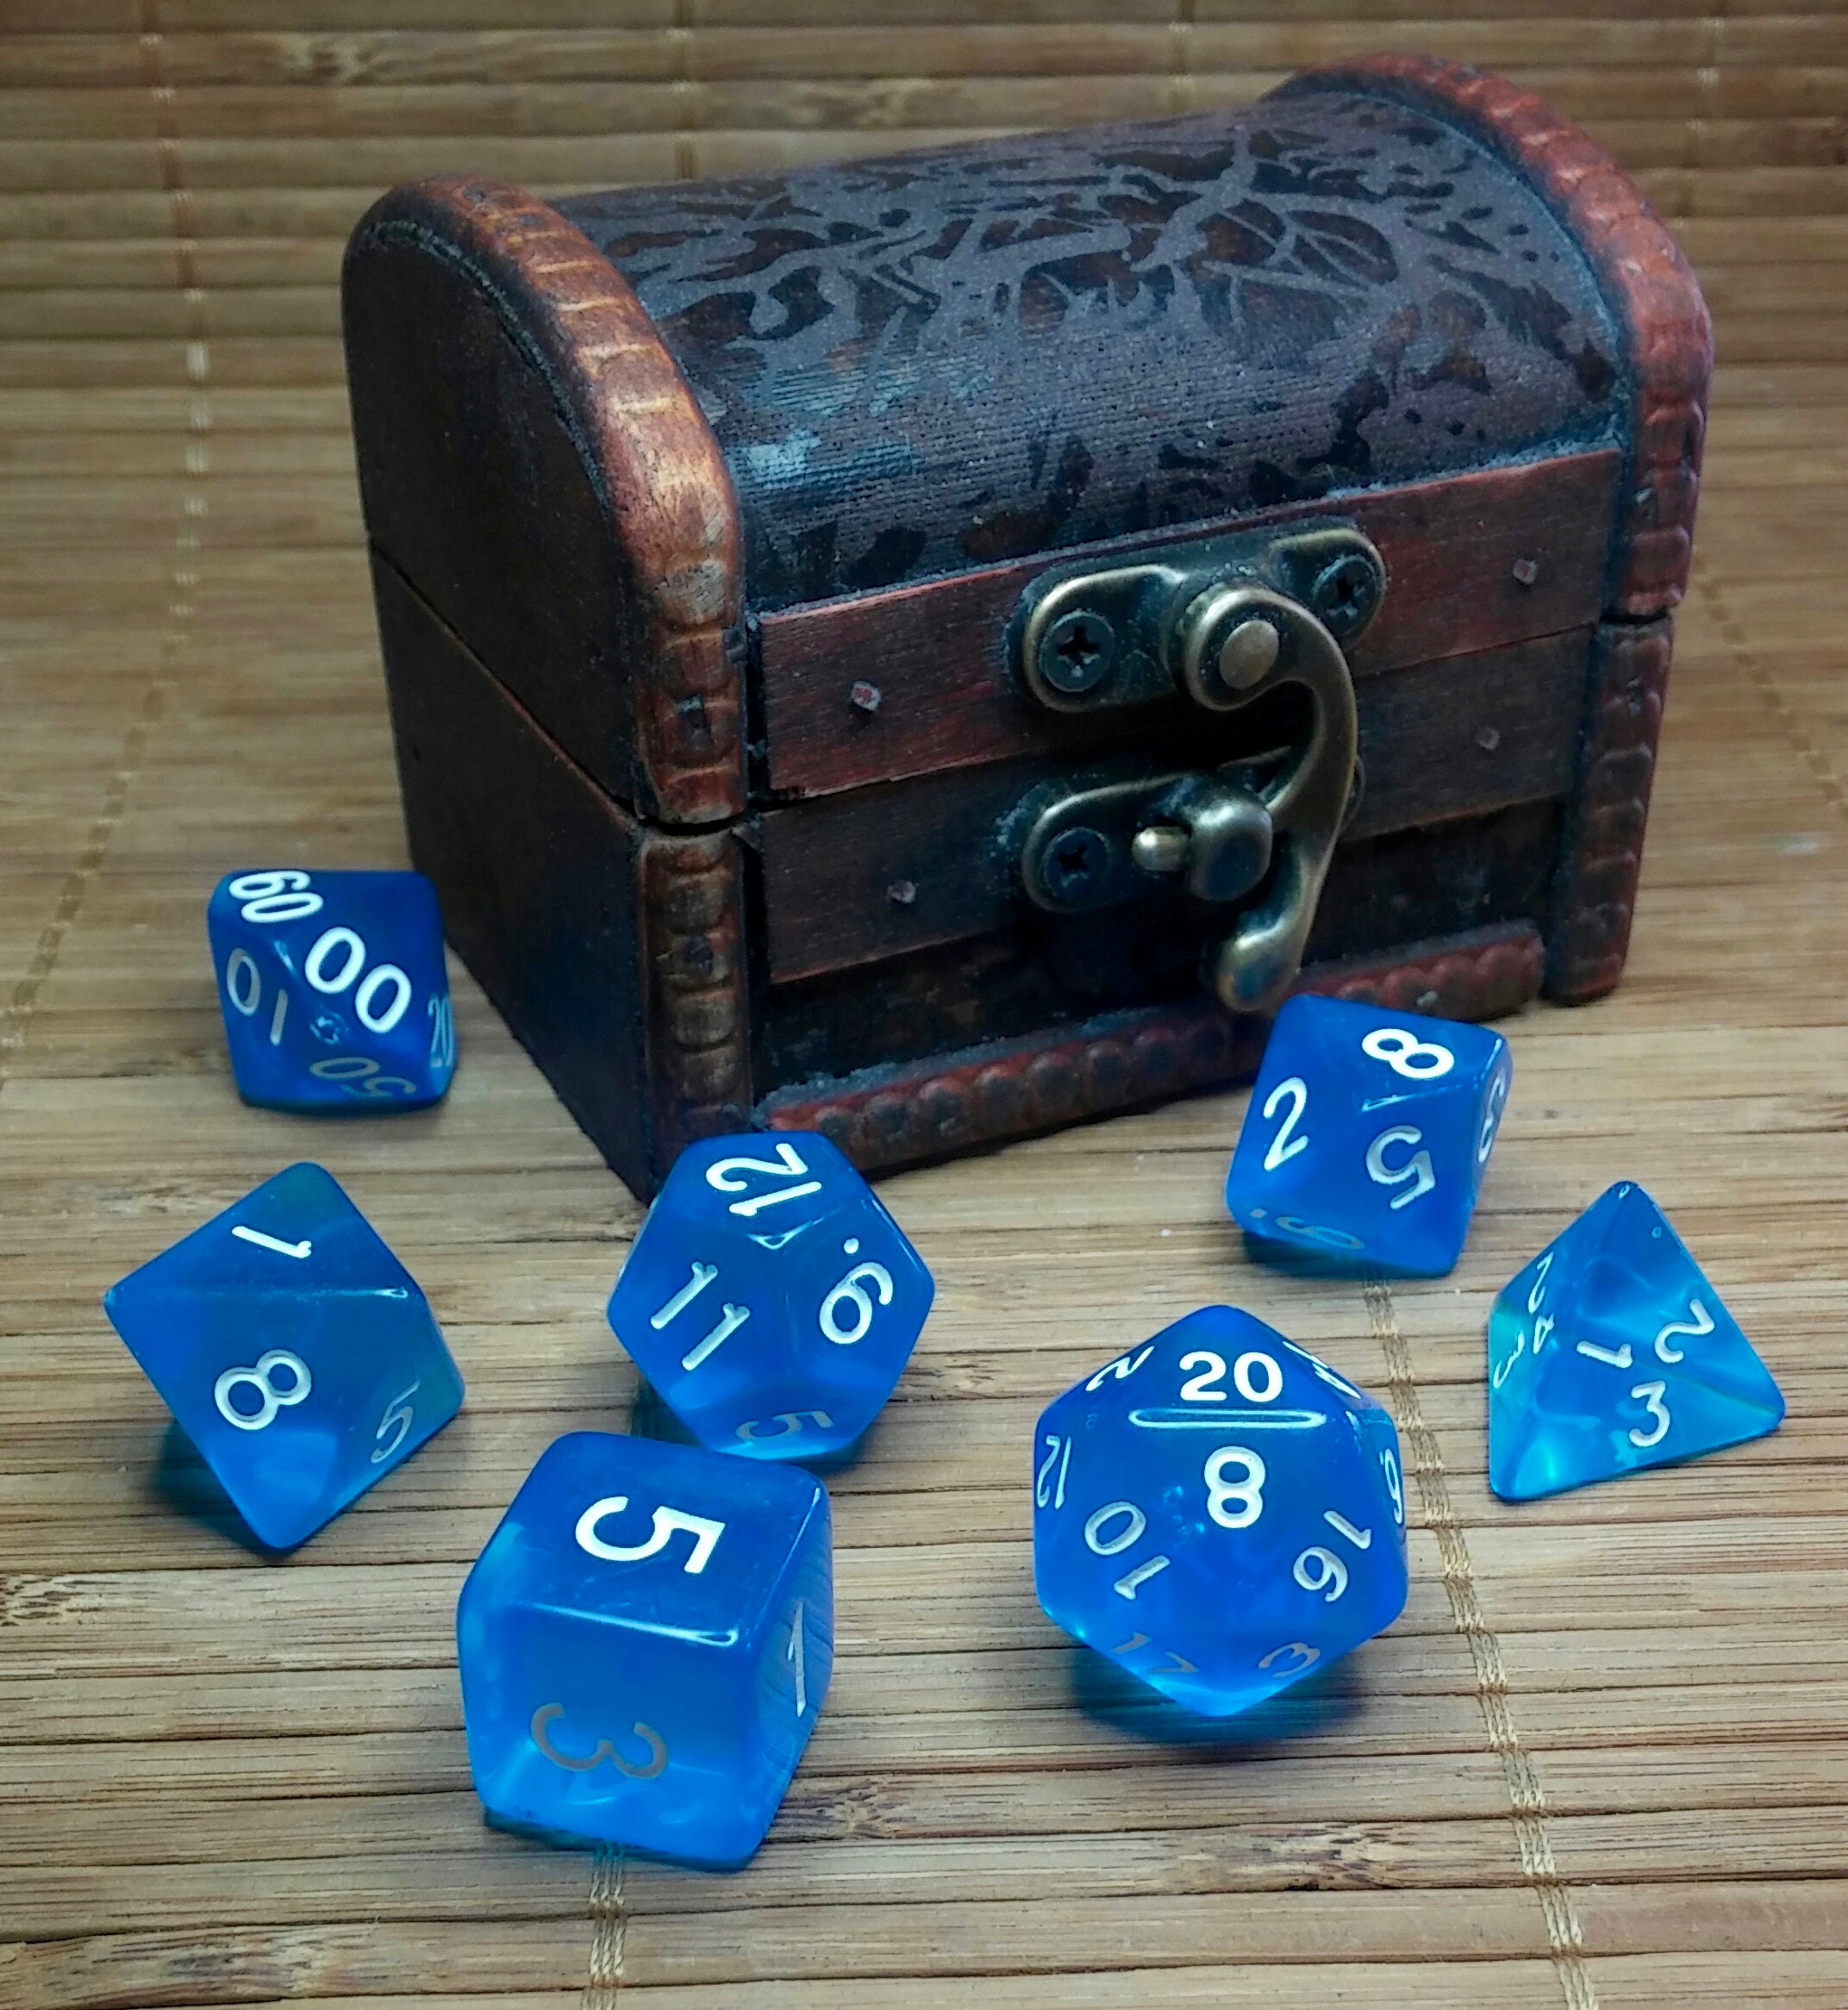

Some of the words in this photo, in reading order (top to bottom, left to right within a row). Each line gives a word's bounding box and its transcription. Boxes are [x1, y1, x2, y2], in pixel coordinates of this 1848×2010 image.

[304, 927, 412, 1033] 00
[1362, 1028, 1455, 1079] 8
[1263, 1077, 1309, 1171] 2
[705, 1143, 822, 1216] 12
[1366, 1125, 1436, 1209] 5
[231, 1226, 312, 1258] 1
[650, 1261, 751, 1370] 11
[1654, 1299, 1715, 1364] 2
[215, 1350, 312, 1431] 8
[1085, 1345, 1155, 1392] 2
[1179, 1351, 1283, 1403] 20
[1576, 1341, 1633, 1369] 1
[370, 1381, 420, 1464] 5
[735, 1410, 835, 1443] 5
[1629, 1380, 1670, 1447] 3
[1203, 1445, 1266, 1529] 8
[575, 1495, 726, 1574] 5
[1084, 1501, 1171, 1601] 10
[1293, 1510, 1372, 1602] 16
[786, 1601, 807, 1718] 1
[1258, 1642, 1321, 1679] 3
[530, 1702, 668, 1779] 3
